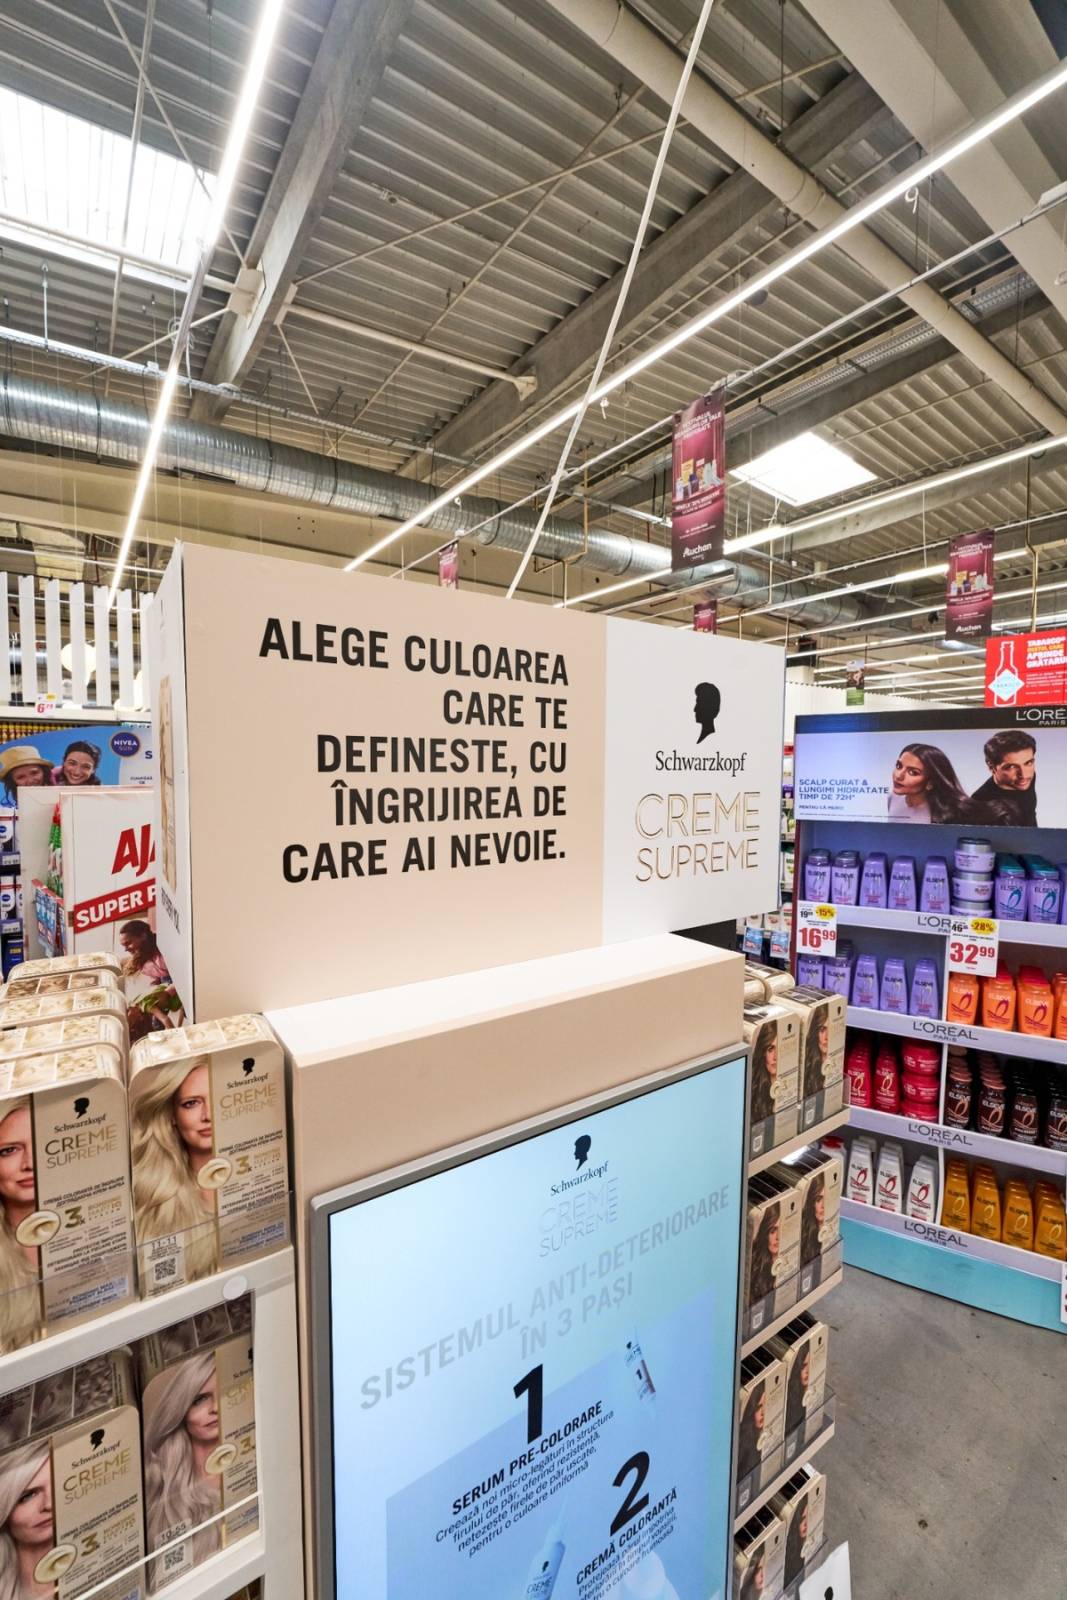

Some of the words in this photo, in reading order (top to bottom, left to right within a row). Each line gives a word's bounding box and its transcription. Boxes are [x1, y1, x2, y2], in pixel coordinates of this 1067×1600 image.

[683, 543, 712, 558] Auchan
[259, 617, 389, 669] ALEGE
[404, 635, 568, 686] CULOAREA
[443, 689, 524, 727] CARE
[535, 697, 567, 729] TE
[317, 734, 518, 780] DEFINESTE,
[530, 741, 567, 773] CU
[655, 750, 747, 778] Schwarzkopf
[330, 779, 522, 826] ÎNGRIJIREA
[533, 786, 567, 817] DE
[799, 778, 827, 786] SCALP
[836, 786, 890, 794] HIDRATATE
[635, 791, 761, 841] CREME
[111, 823, 156, 878] AJ
[282, 839, 388, 883] CARE
[402, 836, 435, 873] AI
[451, 829, 566, 869] NEVOIE.
[635, 838, 759, 882] SUPREME
[74, 891, 146, 929] SUPER
[970, 920, 994, 933] -28%
[912, 1020, 979, 1041] L'ORÉAL
[932, 1033, 958, 1043] PARIS
[220, 1082, 278, 1109] CREME
[226, 1072, 269, 1090] Schwarzkopf
[44, 1123, 118, 1156] CREME
[53, 1113, 107, 1134] Schwarzkopf
[907, 1123, 974, 1146] L'ORÉAL
[928, 1136, 953, 1146] PARIS
[46, 1140, 120, 1169] SUPREME
[550, 1160, 609, 1197] Schwarzkopf
[541, 1177, 620, 1234] CREME
[538, 1203, 619, 1258] SUPREME
[904, 1220, 969, 1248] L'ORÉAL
[360, 1301, 521, 1411] SISTEMUL
[529, 1184, 731, 1319] ANTI-DETERIORARE
[519, 1321, 547, 1361] ÎN
[557, 1306, 573, 1337] 3
[582, 1271, 633, 1324] PAȘI
[513, 1362, 544, 1445] 1
[62, 1447, 131, 1493] CREME
[71, 1440, 121, 1470] Schwarzkopf
[452, 1467, 505, 1516] SERUM
[509, 1399, 603, 1476] PRE-COLORARE
[64, 1464, 131, 1505] SUPREME
[435, 1505, 480, 1543] Creează
[481, 1492, 498, 1511] noi
[499, 1445, 566, 1499] micro-legături
[576, 1410, 615, 1447] structura
[609, 1450, 650, 1538] 2
[452, 1515, 484, 1544] firului
[485, 1506, 500, 1522] de
[521, 1466, 556, 1494] oferind
[458, 1509, 509, 1553] netezește
[510, 1495, 534, 1516] firele
[535, 1480, 549, 1499] de
[549, 1468, 565, 1491] păr
[468, 1526, 504, 1558] pentru
[504, 1518, 513, 1530] o
[513, 1492, 549, 1524] culoare
[549, 1460, 590, 1497] uniformă
[576, 1539, 616, 1586] CREMĂ
[618, 1486, 678, 1549] COLORANTĂ
